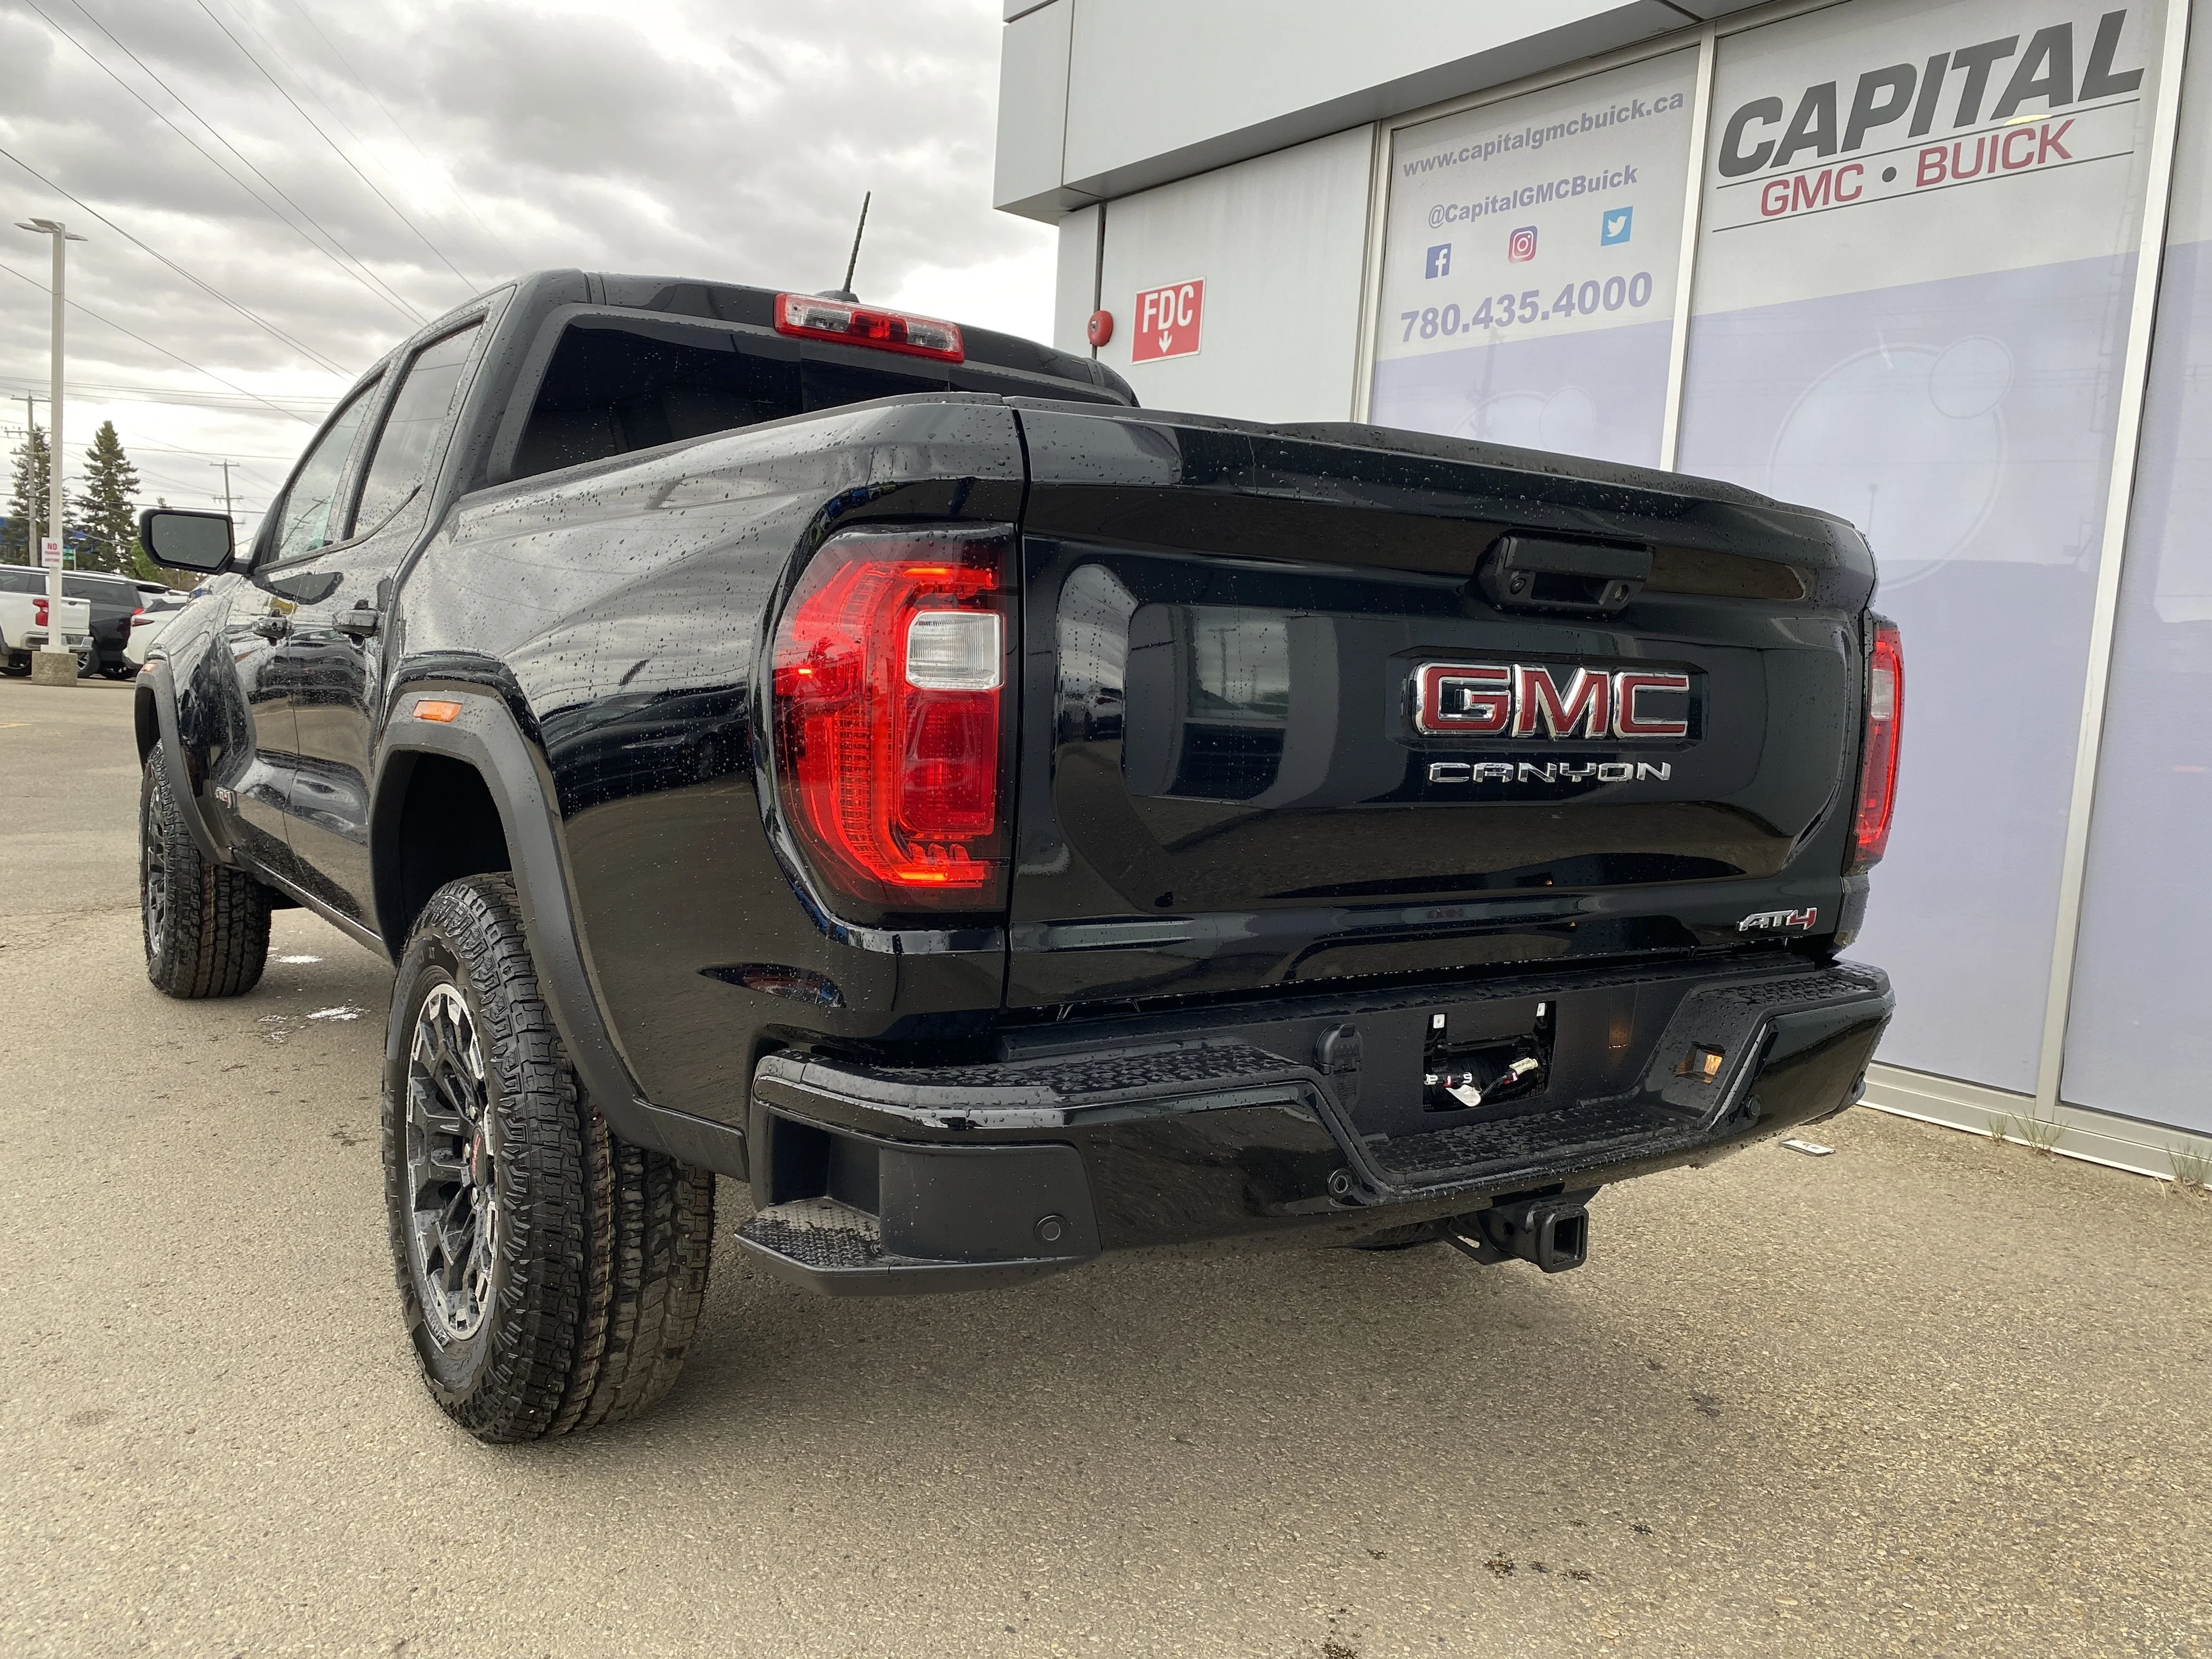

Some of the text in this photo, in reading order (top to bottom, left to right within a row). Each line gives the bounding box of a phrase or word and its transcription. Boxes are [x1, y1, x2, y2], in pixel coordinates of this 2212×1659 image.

[1718, 9, 2145, 177] CAPITAL
[1403, 93, 1684, 177] www.capitalgmcbuick.ca
[1760, 119, 2076, 216] GMC BUICK
[1429, 165, 1638, 228] @CapitalGMCBuick
[1143, 285, 1194, 333] FDC
[1401, 272, 1653, 342] 780.435.4000
[1414, 663, 1689, 740] GMC
[1429, 763, 1671, 783] CANYON
[1739, 907, 1818, 931] AT4
